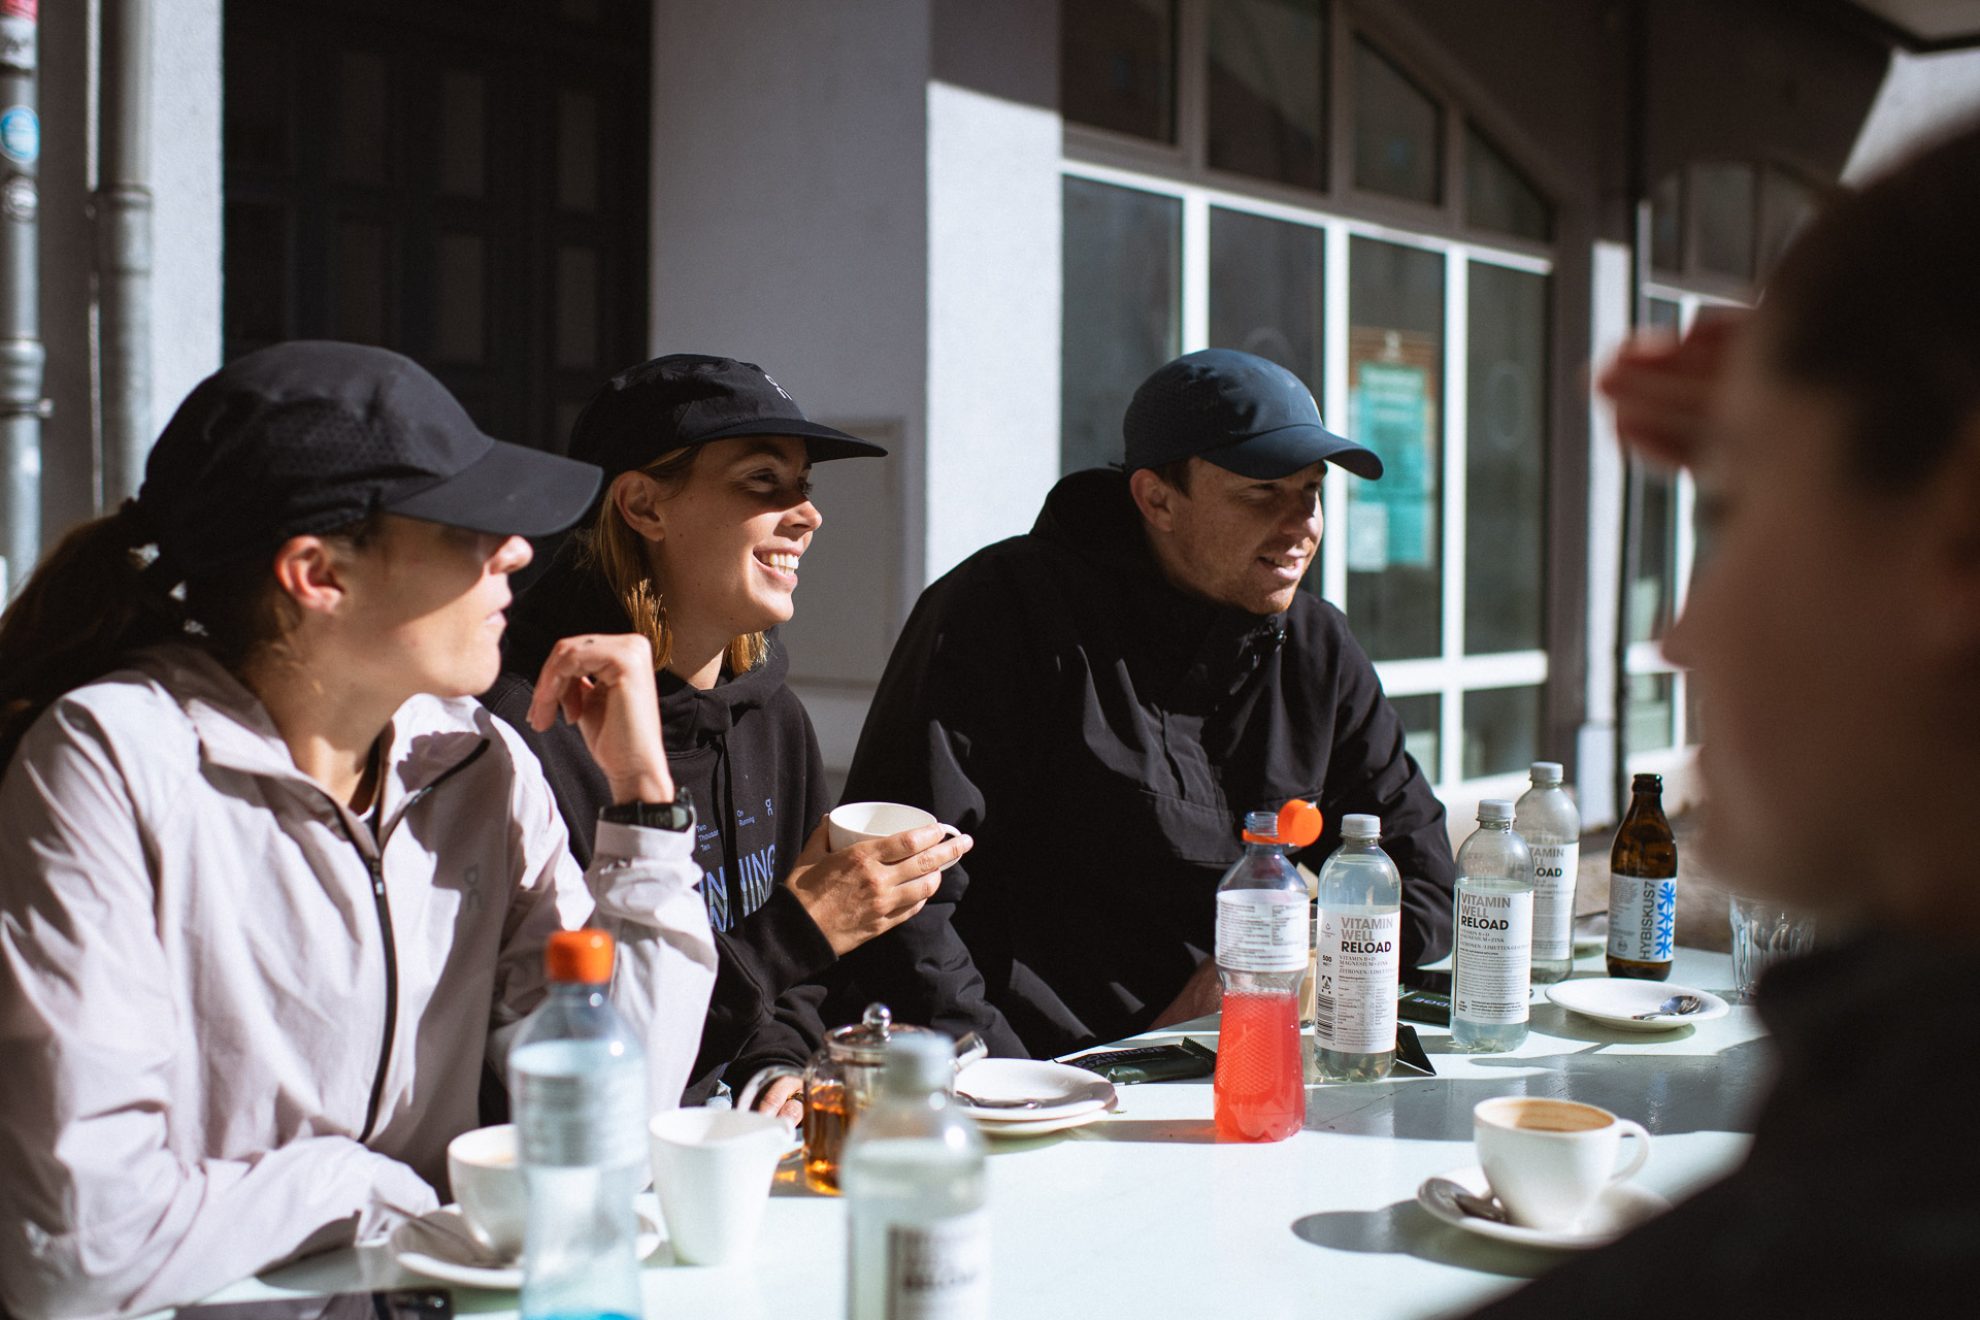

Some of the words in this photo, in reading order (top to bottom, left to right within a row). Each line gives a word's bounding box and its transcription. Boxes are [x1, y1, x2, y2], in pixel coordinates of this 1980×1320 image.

[1535, 867, 1563, 878] OAD
[1461, 892, 1511, 909] VITAMIN
[1461, 903, 1489, 918] WELL
[1341, 916, 1394, 930] VITAMIN
[1461, 915, 1510, 931] RELOAD
[1341, 929, 1375, 941] WELL
[1341, 941, 1392, 954] RELOAD
